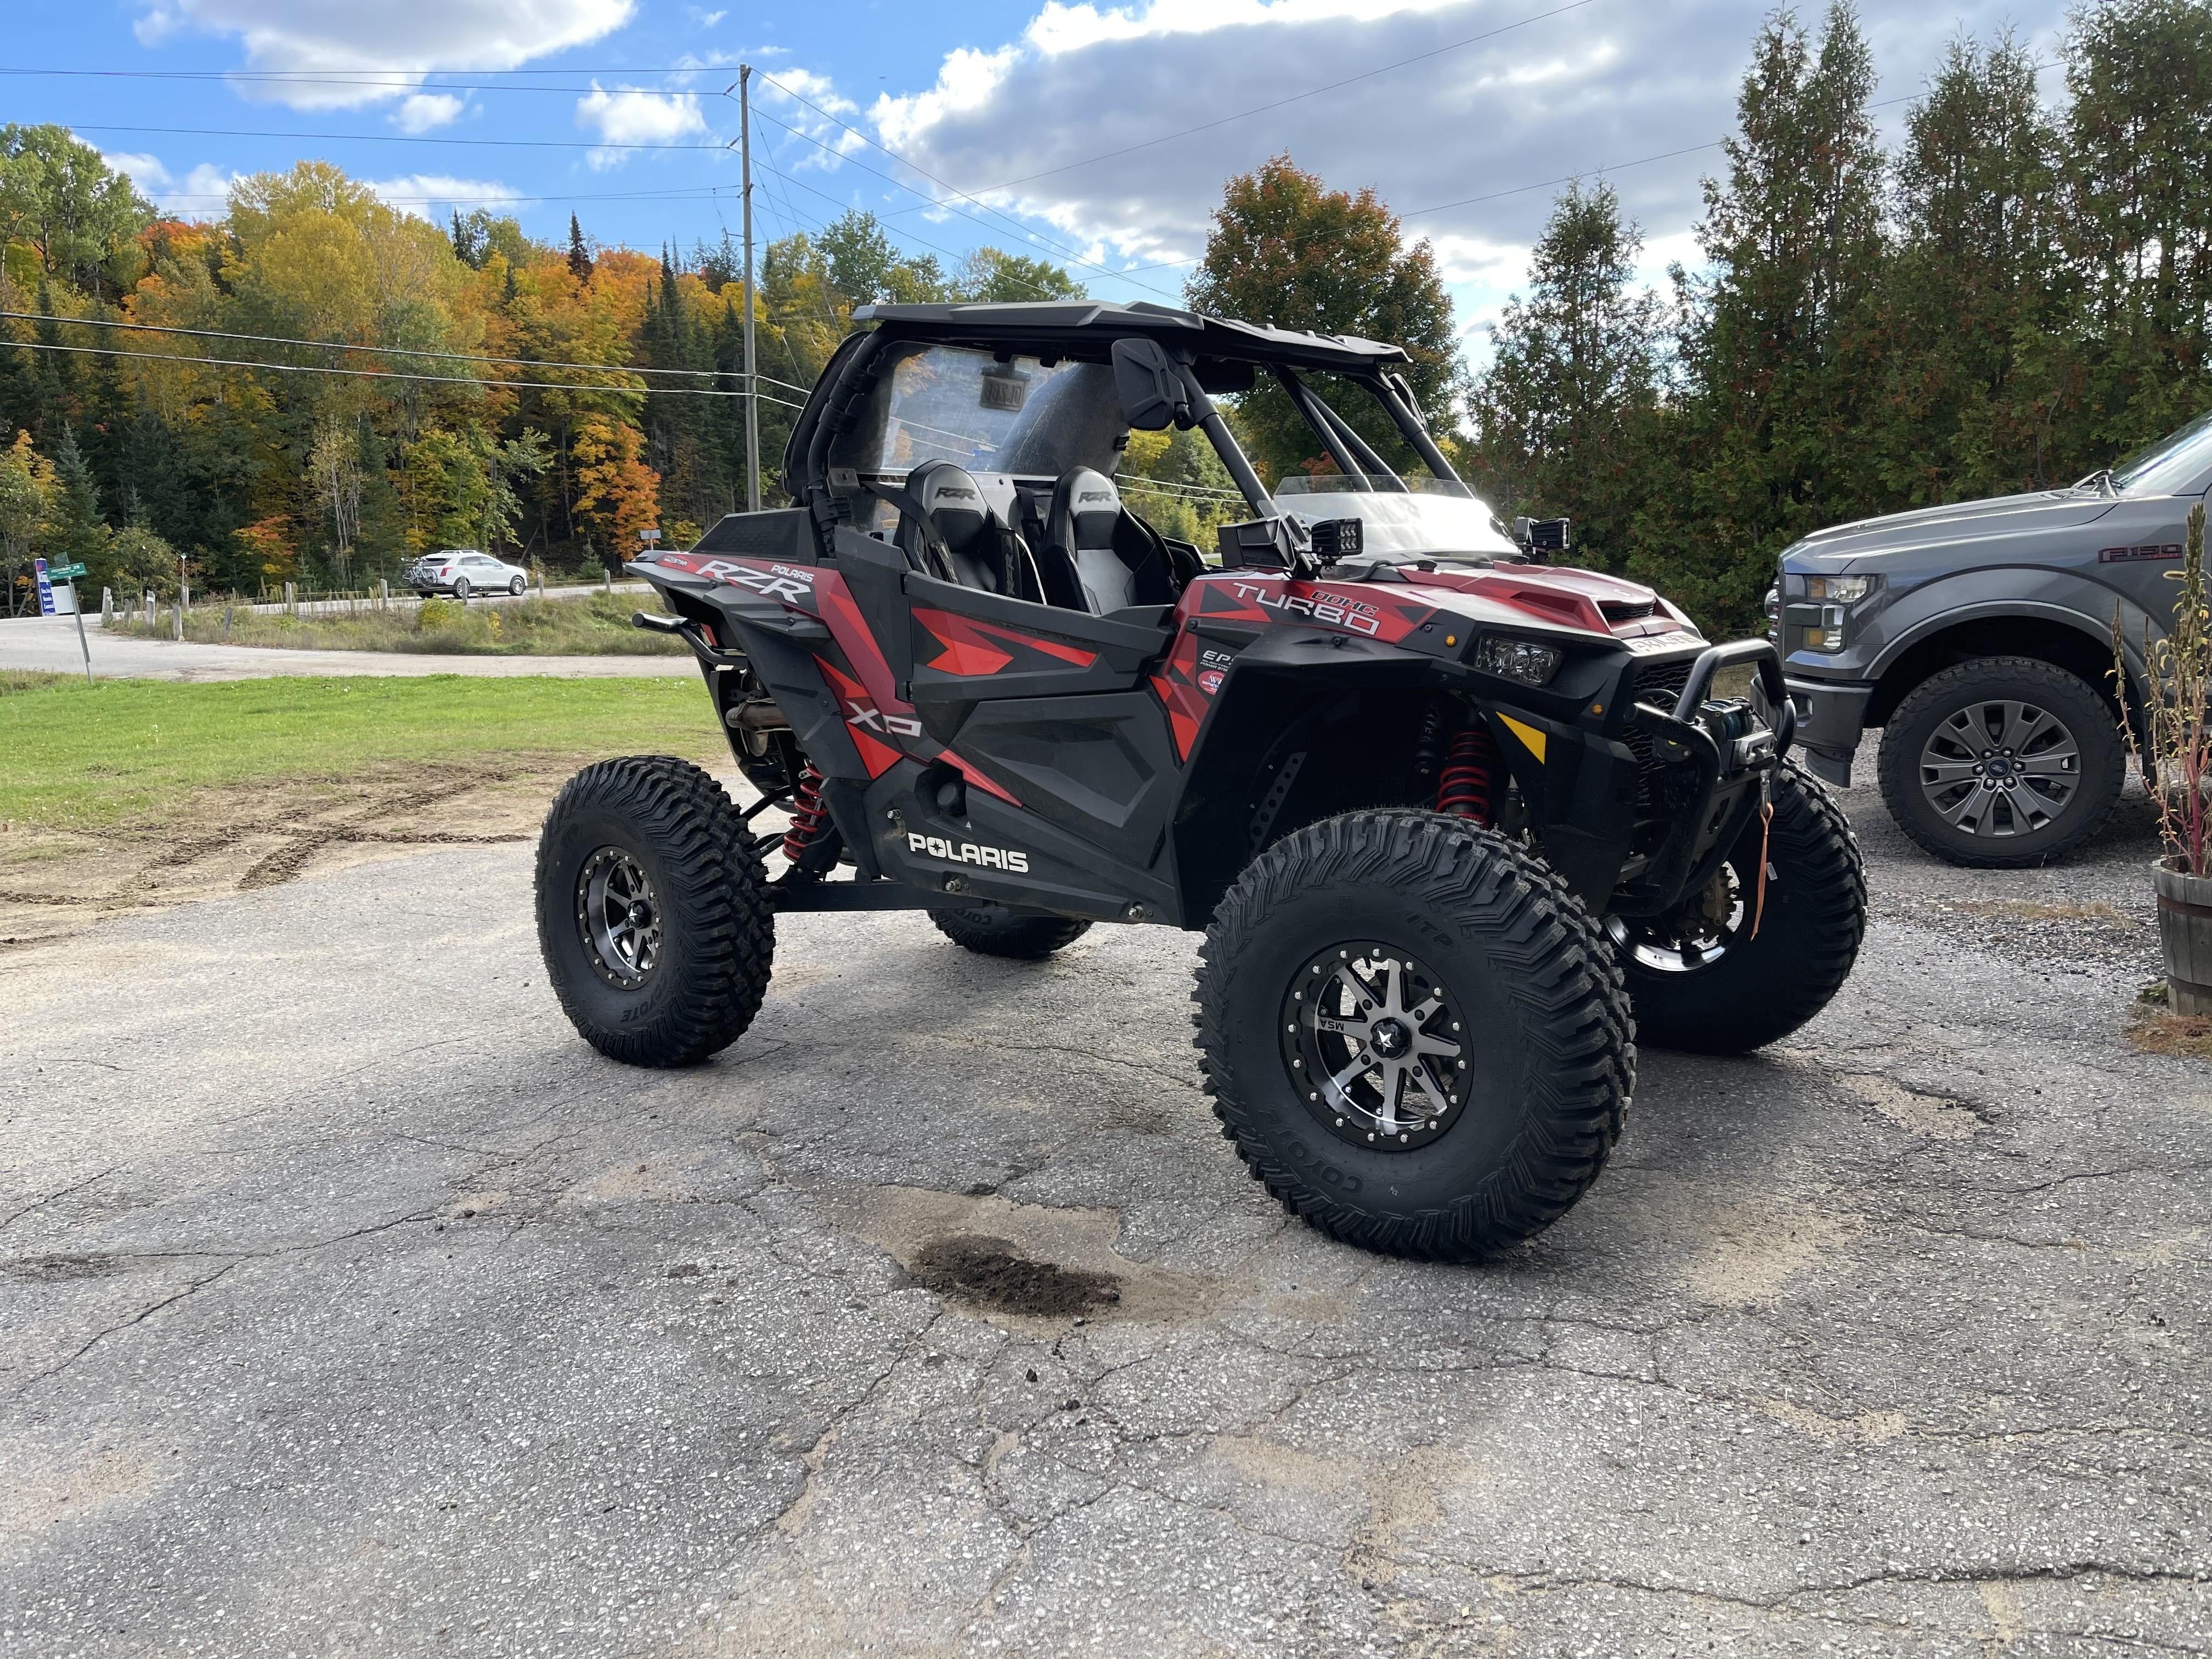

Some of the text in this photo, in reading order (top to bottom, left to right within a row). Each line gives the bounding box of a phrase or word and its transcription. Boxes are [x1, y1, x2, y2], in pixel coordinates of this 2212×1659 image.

[934, 486, 975, 500] RZR
[1078, 490, 1111, 504] RZR
[664, 556, 687, 567] PROSTAR
[695, 560, 811, 604] RZR
[771, 564, 815, 583] POLARIS
[1233, 582, 1380, 635] TURBO
[1310, 590, 1379, 617] DOHC
[1203, 650, 1234, 665] EP
[846, 701, 922, 737] XP
[908, 832, 1029, 873] POLARIS
[1406, 914, 1453, 947] ITP
[1320, 1019, 1344, 1031] MSA
